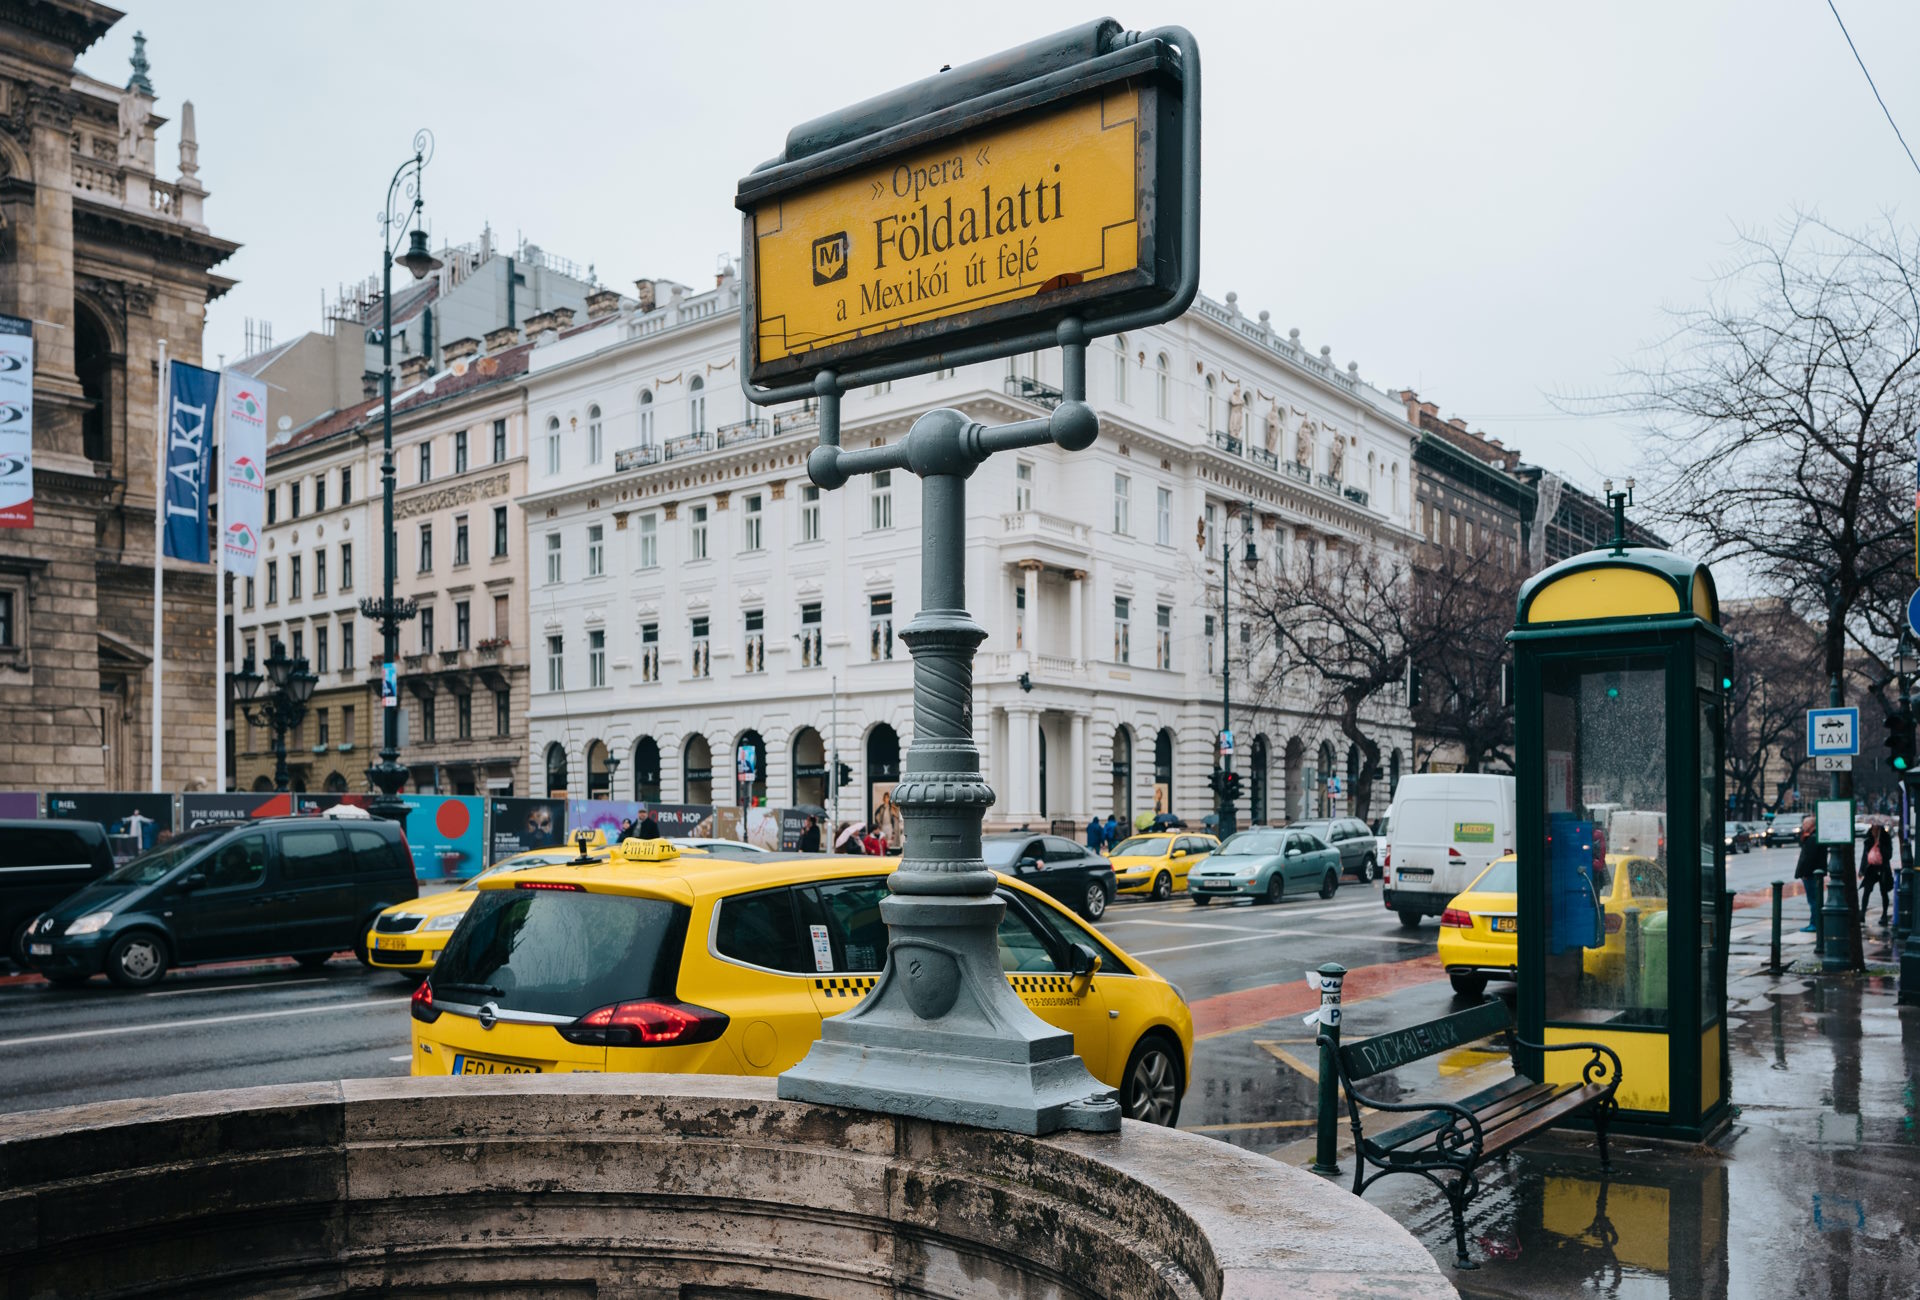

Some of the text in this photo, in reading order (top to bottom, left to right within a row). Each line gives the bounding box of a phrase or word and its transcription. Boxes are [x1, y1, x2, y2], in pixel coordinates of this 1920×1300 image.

[892, 156, 965, 203] Opera
[873, 164, 1065, 270] Földalatti
[836, 236, 1040, 322] a Mexikói út felé
[167, 395, 206, 523] LAKI
[1818, 732, 1848, 745] TAXI
[190, 809, 245, 819] THE OPERA IS
[1499, 919, 1517, 929] ED
